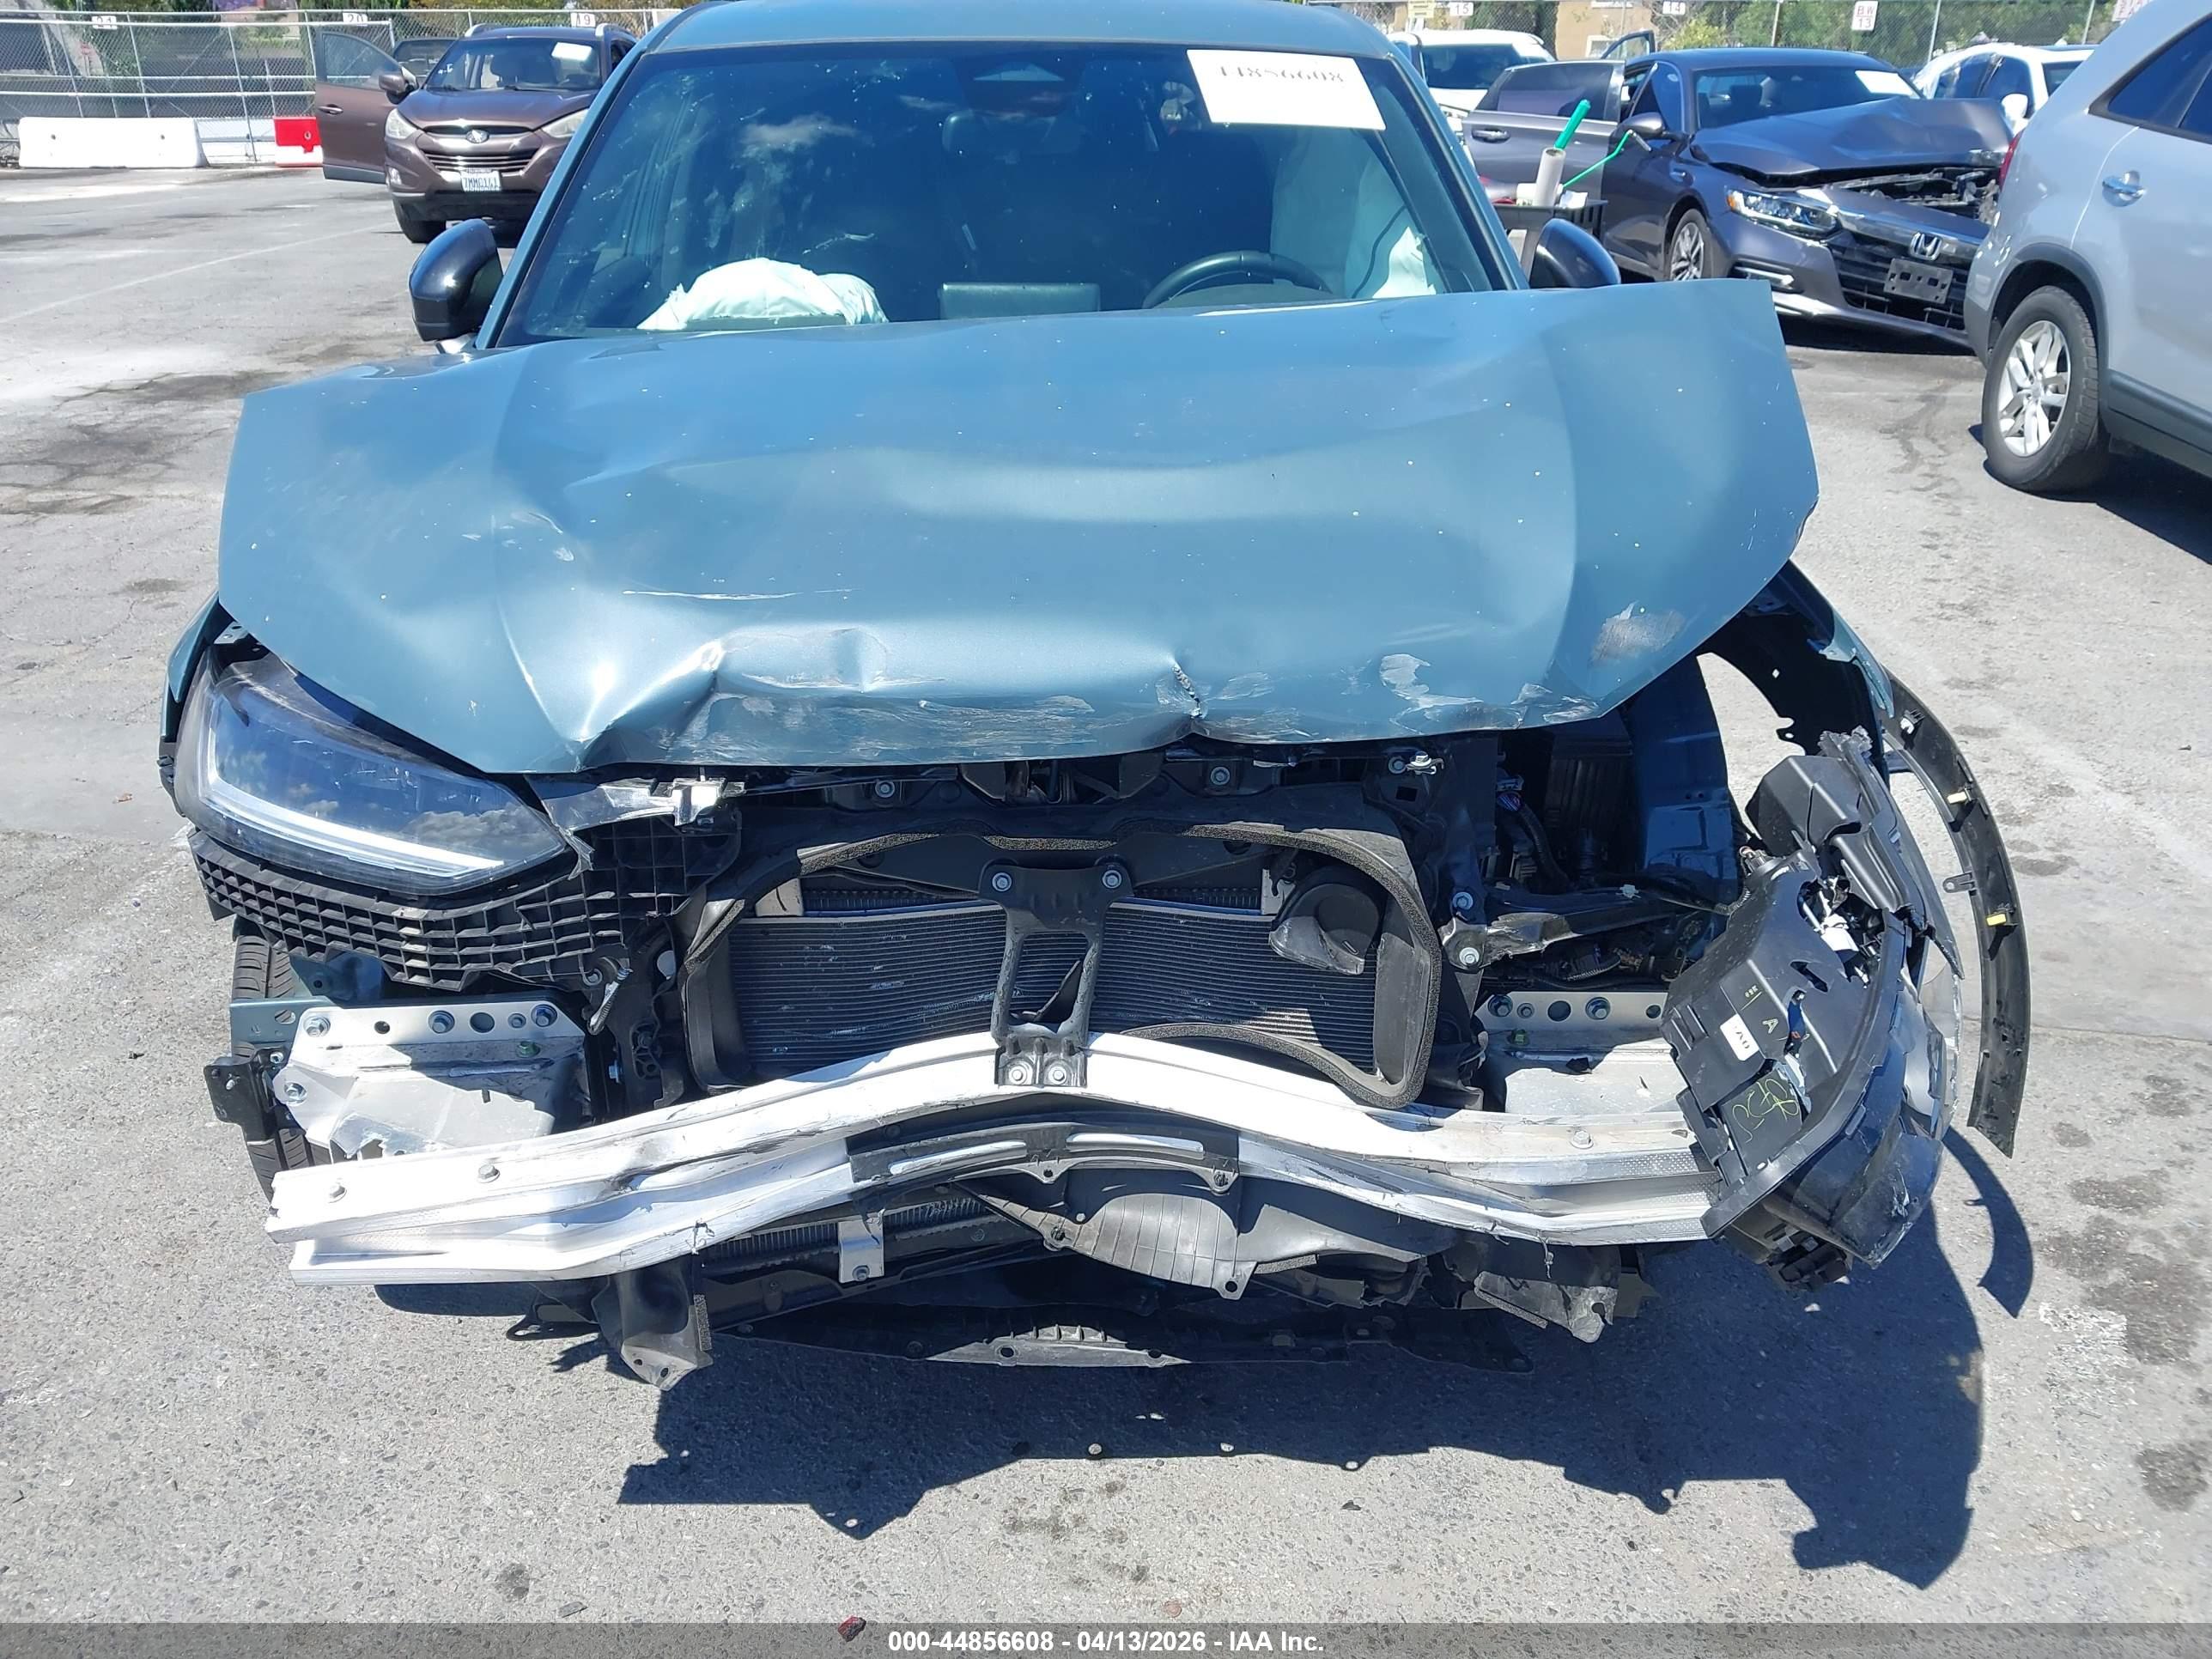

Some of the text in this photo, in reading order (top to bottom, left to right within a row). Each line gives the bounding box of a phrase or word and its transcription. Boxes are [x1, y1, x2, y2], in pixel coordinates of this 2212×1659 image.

[1455, 3, 1469, 15] 15
[576, 13, 591, 26] 19
[1858, 18, 1871, 27] 13
